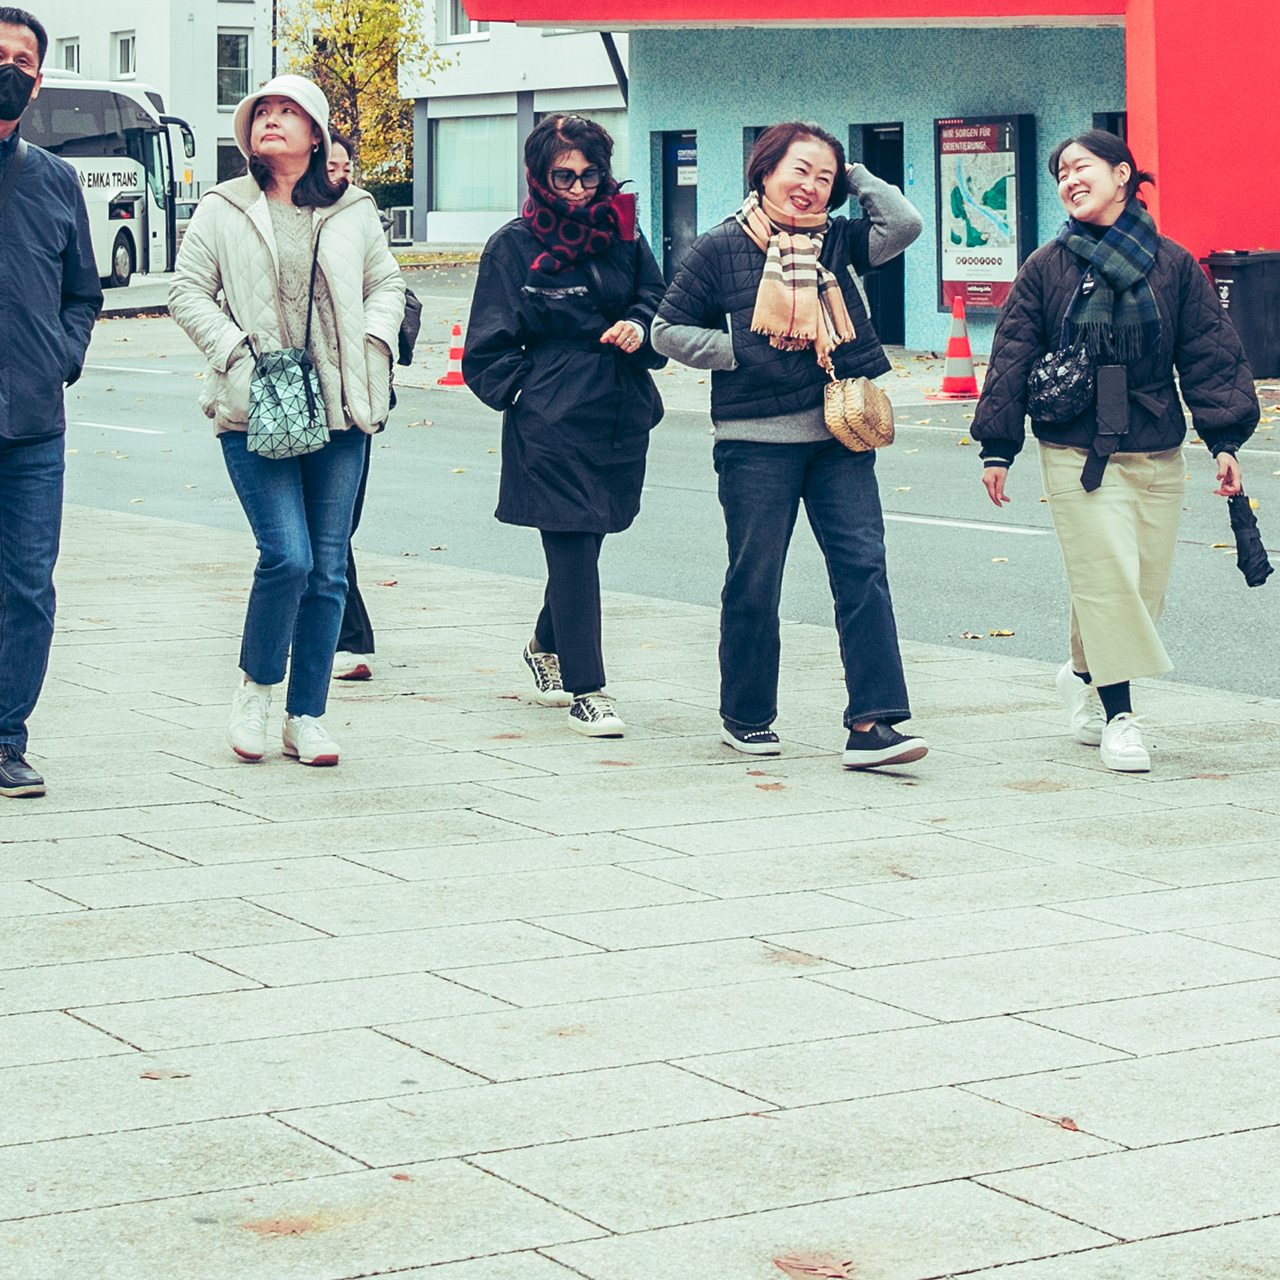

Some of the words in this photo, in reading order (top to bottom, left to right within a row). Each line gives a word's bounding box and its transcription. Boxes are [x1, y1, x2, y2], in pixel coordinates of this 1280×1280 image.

[942, 129, 954, 138] WIR
[955, 128, 979, 138] SORGEN
[979, 126, 991, 137] FÜR
[87, 172, 110, 188] EMKA
[112, 172, 138, 187] TRANS
